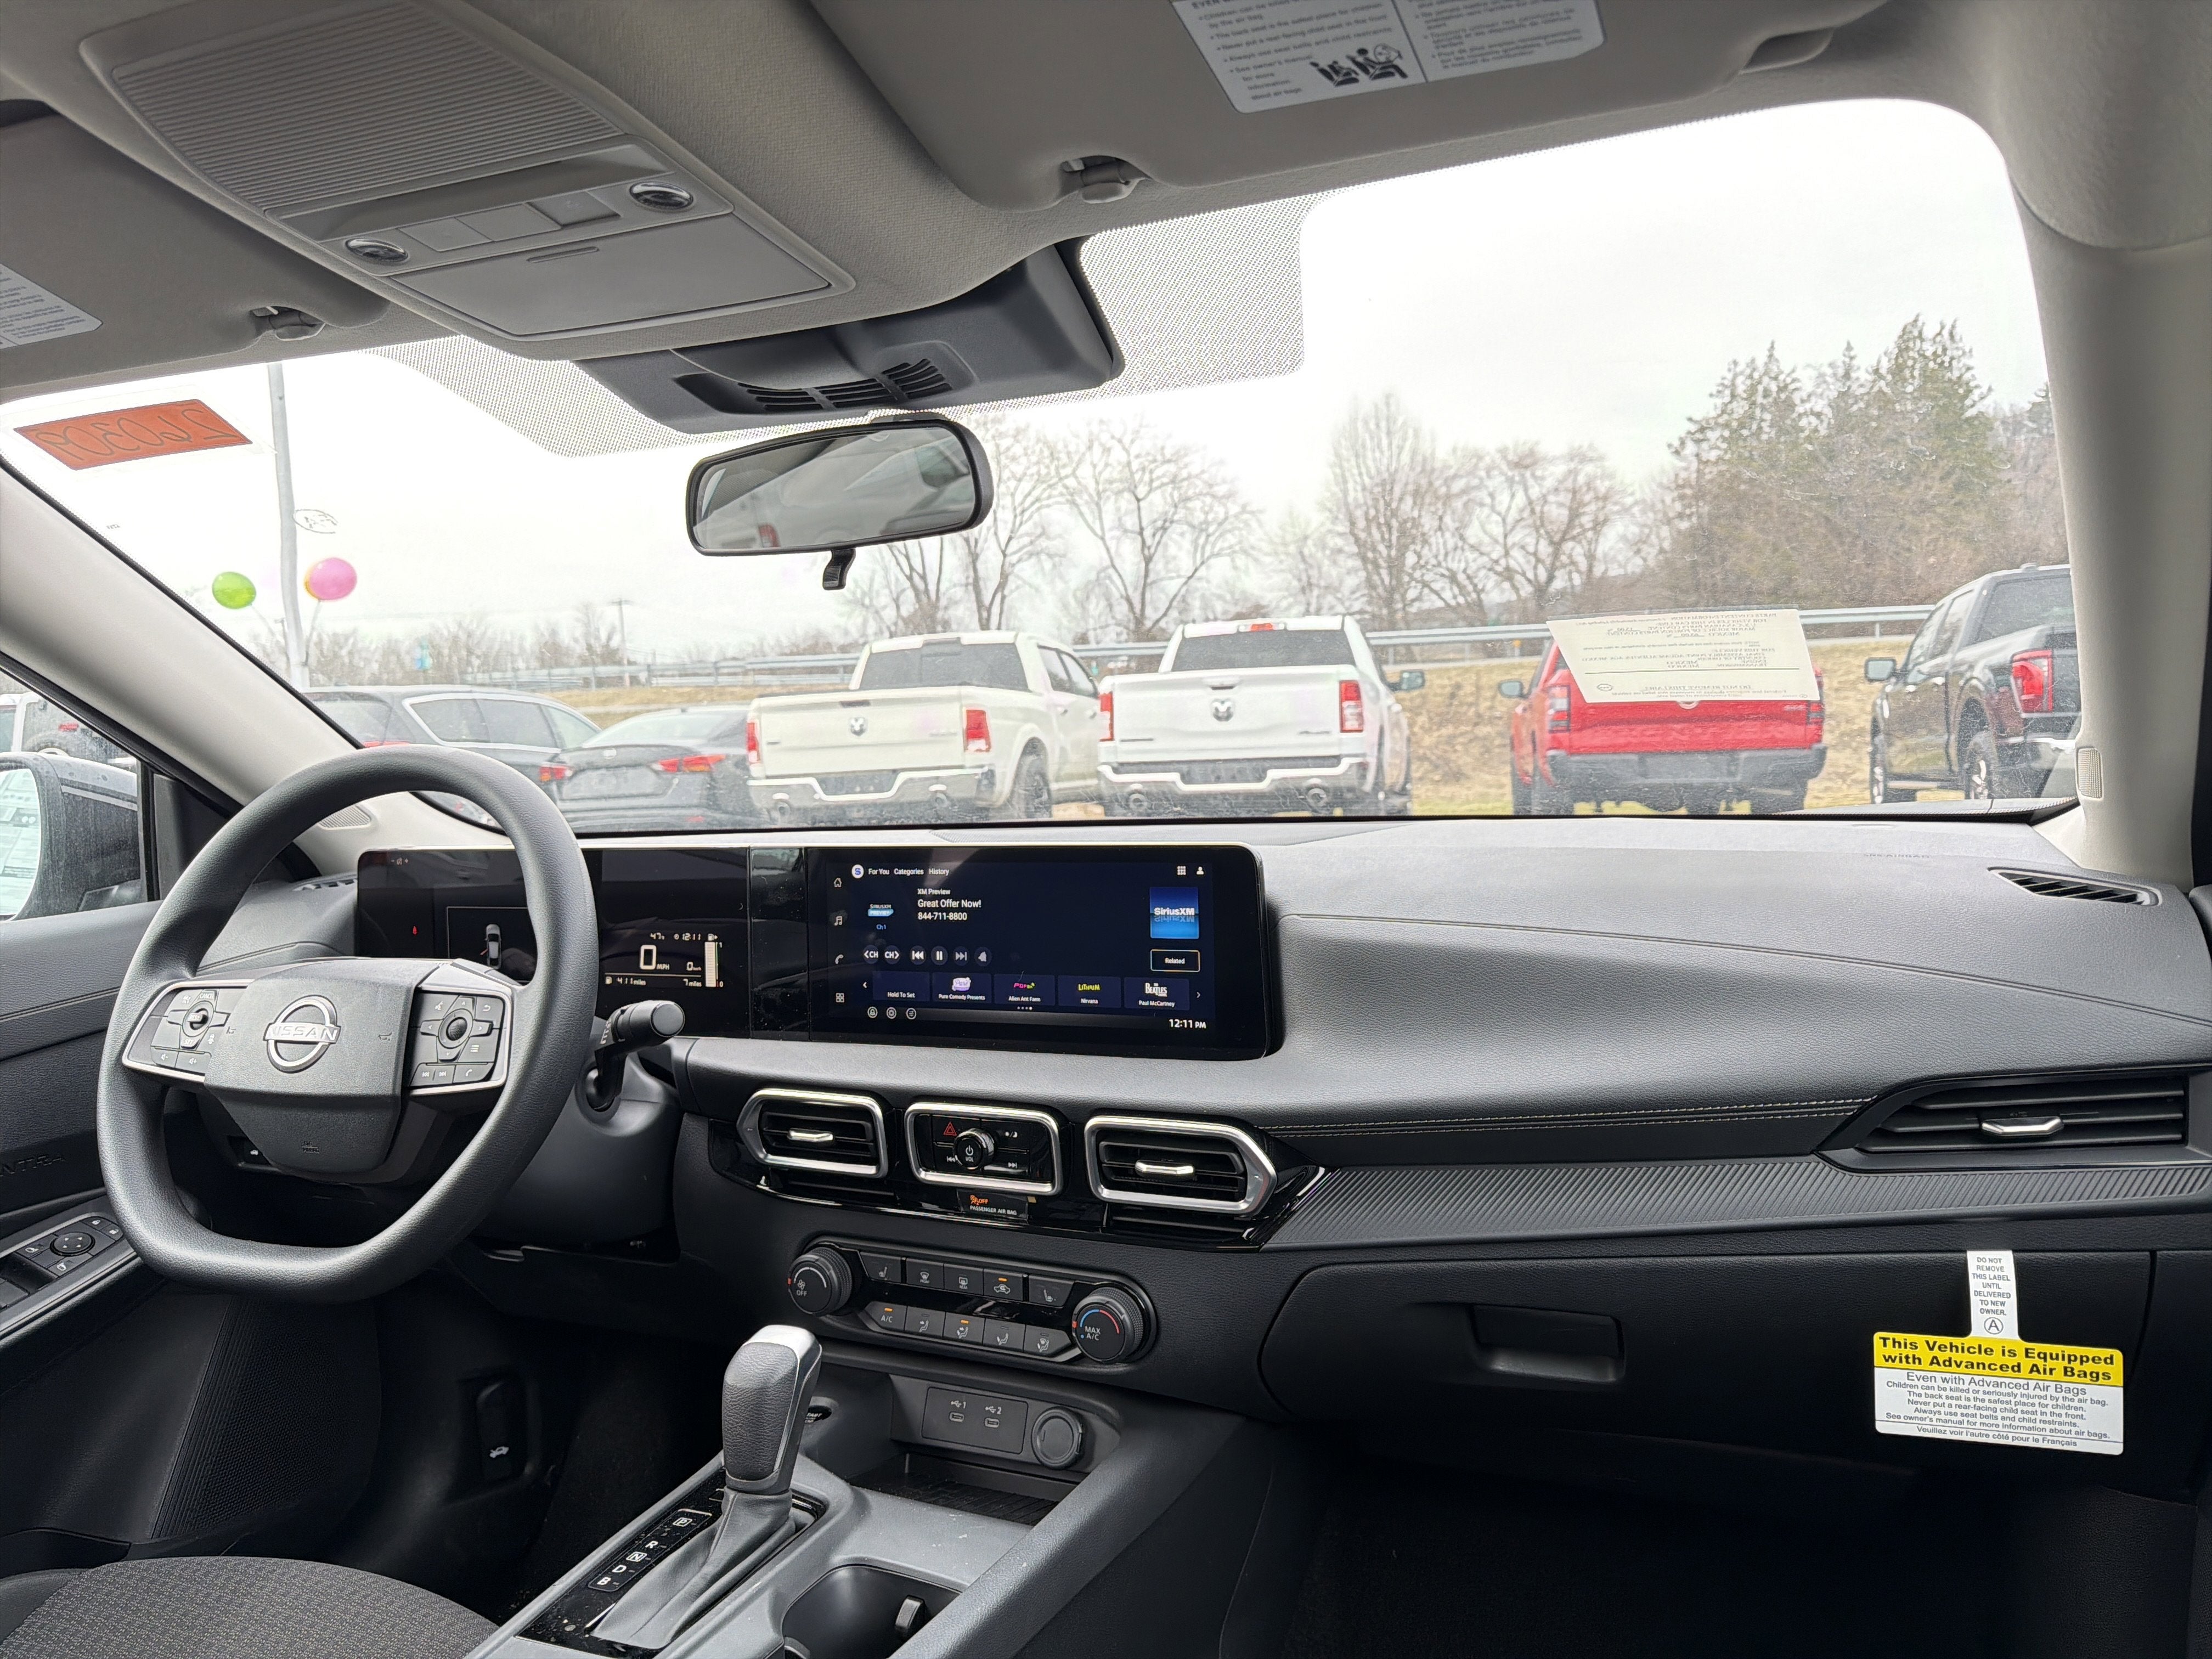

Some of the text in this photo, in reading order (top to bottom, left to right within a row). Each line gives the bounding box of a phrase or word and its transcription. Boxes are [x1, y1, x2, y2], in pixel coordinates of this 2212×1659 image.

[917, 899, 981, 908] Great Offer Now!
[918, 912, 967, 921] 844-711-8800
[1154, 907, 1195, 916] SiriusXM
[1169, 1019, 1193, 1028] 12:11
[269, 1026, 339, 1041] NISSAN
[1974, 1290, 2011, 1299] DELIVERED
[881, 1314, 893, 1323] A/C
[1085, 1325, 1101, 1335] MAX
[1086, 1333, 1099, 1341] A/C
[1878, 1336, 2115, 1367] This Vehicle is Equipped
[1881, 1352, 2112, 1383] with Advanced Air Bags
[1906, 1372, 2086, 1397] Even with Advanced Air Bags
[1887, 1381, 1918, 1390] Children
[1949, 1386, 1970, 1394] killed
[1982, 1390, 2018, 1400] seriously
[2020, 1391, 2047, 1401] injured
[2050, 1394, 2059, 1402] by
[2090, 1398, 2108, 1407] bag.
[1908, 1398, 1931, 1407] Never
[1933, 1401, 1945, 1409] put
[1955, 1402, 1997, 1413] rear-facing
[1999, 1406, 2018, 1414] child
[2021, 1408, 2038, 1416] seat
[2064, 1412, 2086, 1420] front.
[1988, 1397, 2012, 1406] safest
[2014, 1400, 2036, 1408] place
[2051, 1402, 2086, 1412] children.
[1914, 1407, 1942, 1416] Always
[1979, 1413, 1999, 1421] belts
[2018, 1416, 2037, 1424] child
[2039, 1418, 2079, 1428] restraints.
[1916, 1426, 1947, 1435] Veuillez
[1966, 1429, 1990, 1438] l'autre
[1992, 1432, 2010, 1441] côté
[2042, 1437, 2077, 1446] Français
[1936, 1417, 1964, 1425] manual
[2002, 1422, 2047, 1433] information
[2049, 1427, 2072, 1435] about
[2087, 1430, 2110, 1440] bags.
